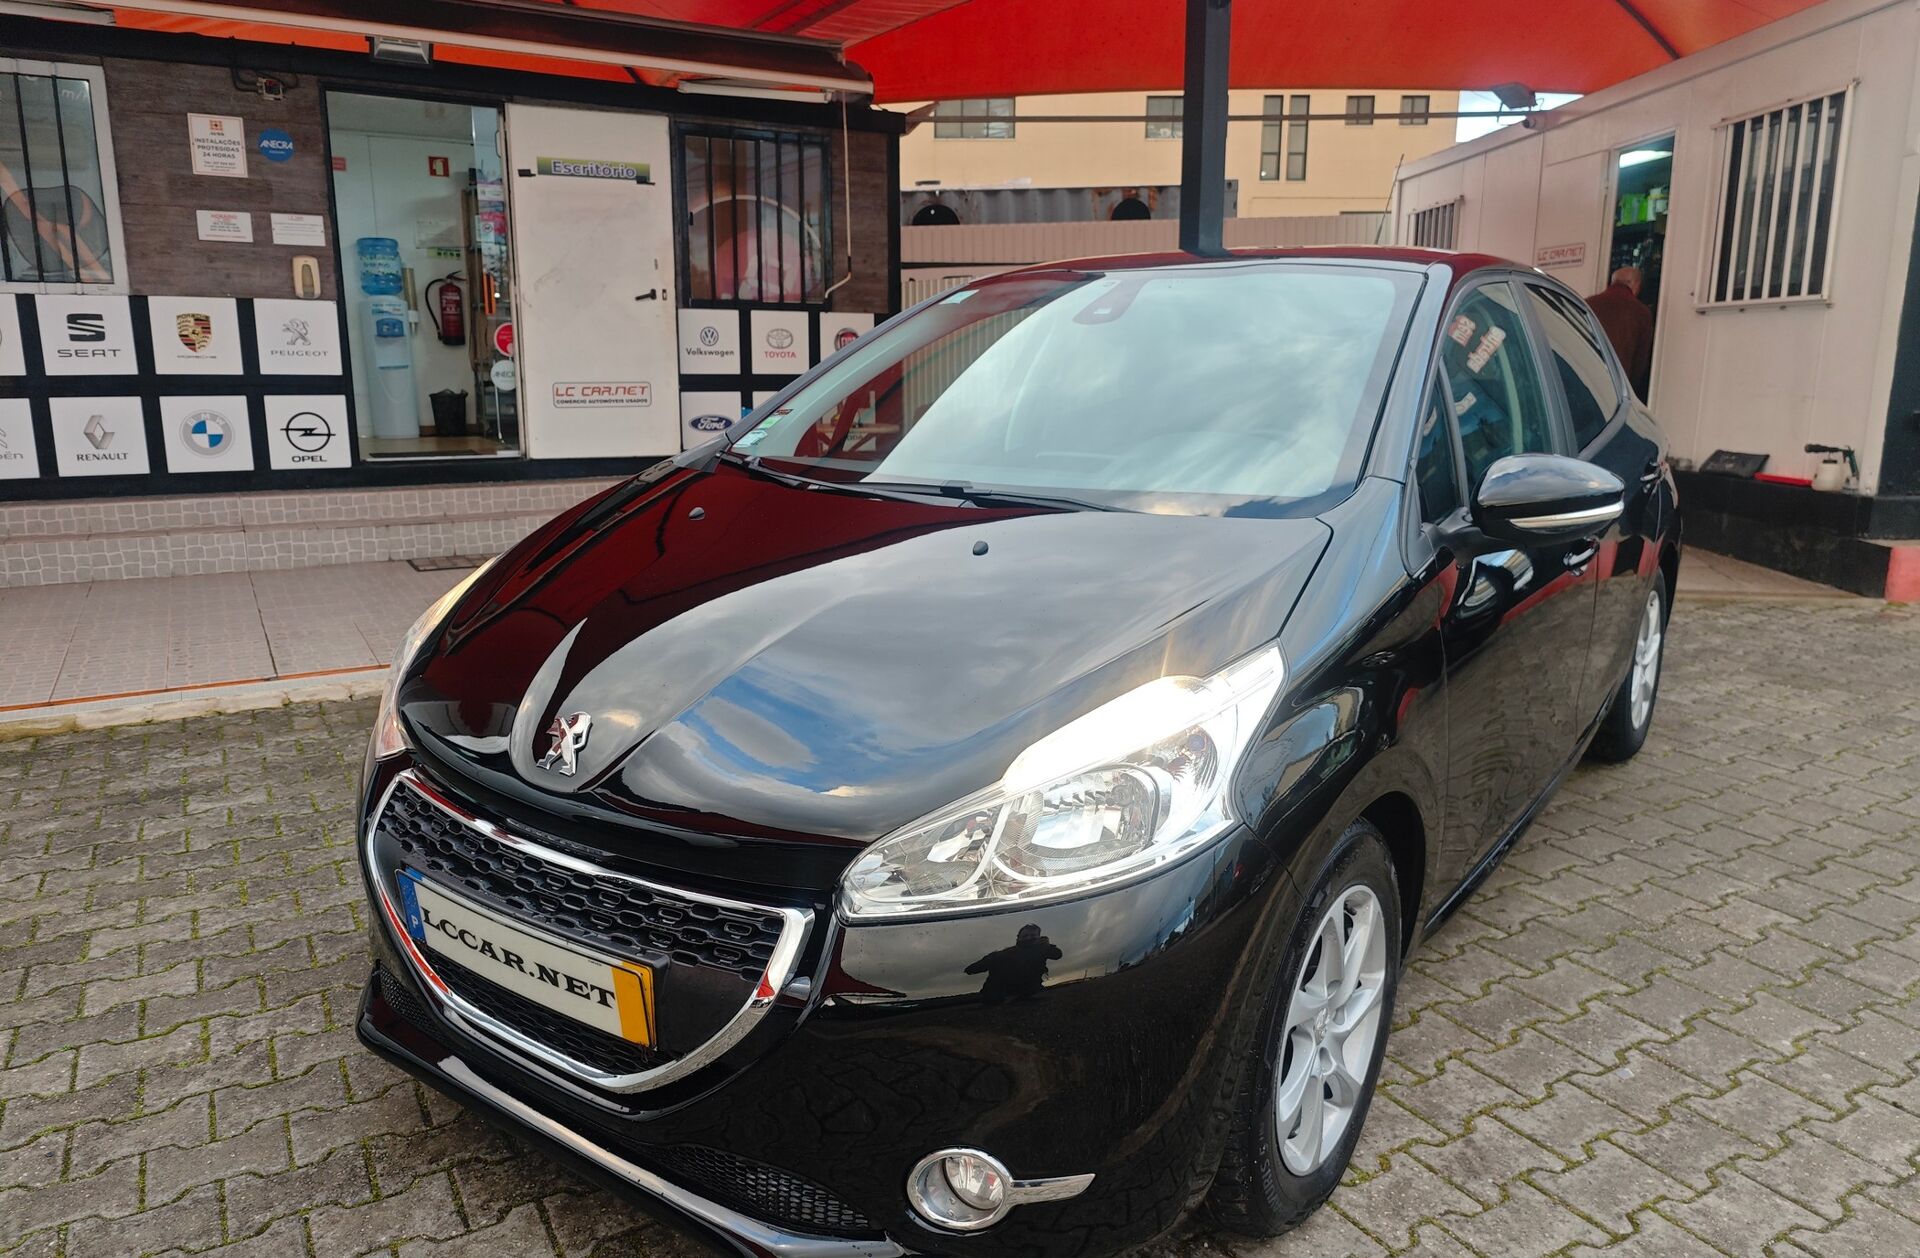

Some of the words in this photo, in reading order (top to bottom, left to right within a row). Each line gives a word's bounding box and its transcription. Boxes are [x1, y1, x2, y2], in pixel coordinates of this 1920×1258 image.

[552, 160, 637, 178] Escritório
[57, 349, 121, 358] SEAT
[685, 347, 735, 357] Volkswagen
[764, 350, 797, 358] TOYOTA
[555, 386, 575, 397] LC
[697, 416, 726, 430] Ford
[76, 452, 129, 461] RENAULT
[291, 455, 328, 463] OPEL
[410, 914, 419, 929] P
[420, 905, 616, 1010] LCCAR.NET
